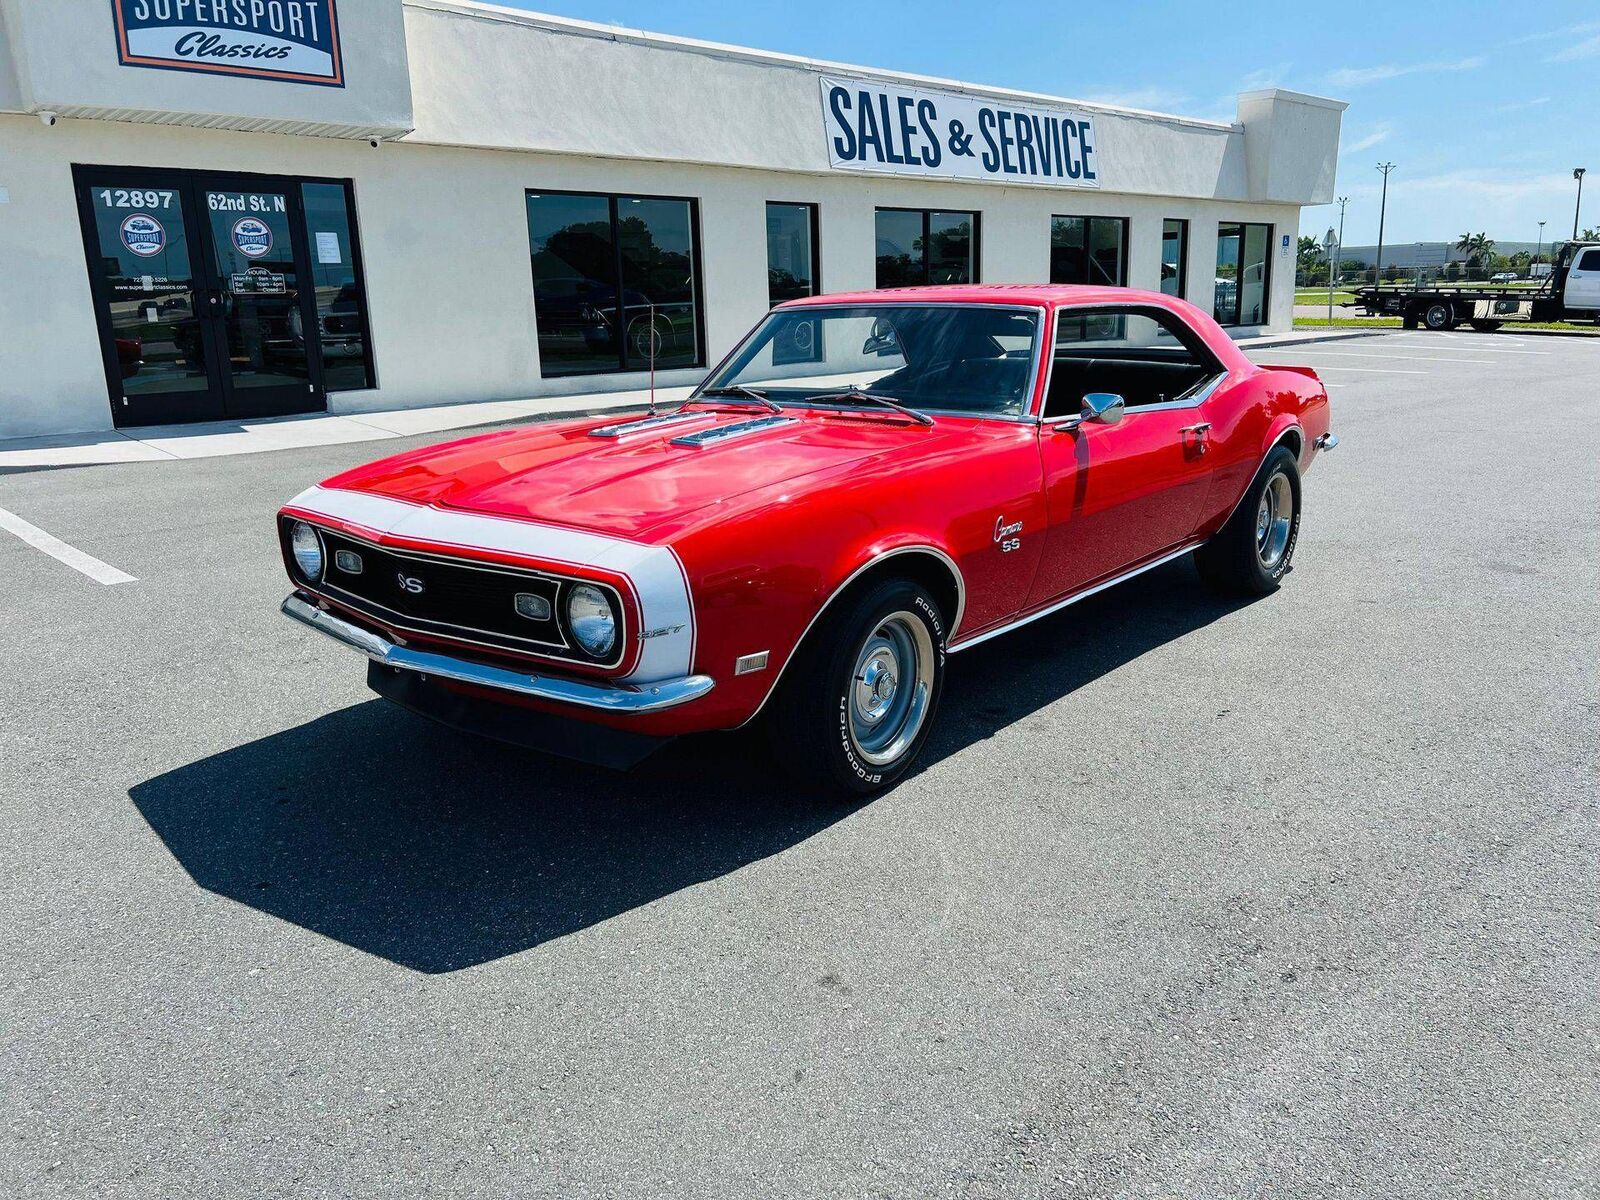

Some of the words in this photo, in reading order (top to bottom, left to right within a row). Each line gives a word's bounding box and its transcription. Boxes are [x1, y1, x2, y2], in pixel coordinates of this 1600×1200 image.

[134, 0, 319, 42] SUPERSPORT
[174, 31, 292, 59] Classics
[829, 86, 942, 168] SALES
[948, 119, 976, 157] &
[978, 108, 1096, 179] SERVICE
[100, 190, 172, 208] 12897
[208, 194, 246, 211] 62nd
[249, 195, 270, 212] St.
[273, 196, 286, 212] N
[1002, 538, 1020, 552] SS
[397, 573, 423, 593] SS
[915, 596, 942, 636] Radial
[840, 696, 882, 784] BFGoodrich
